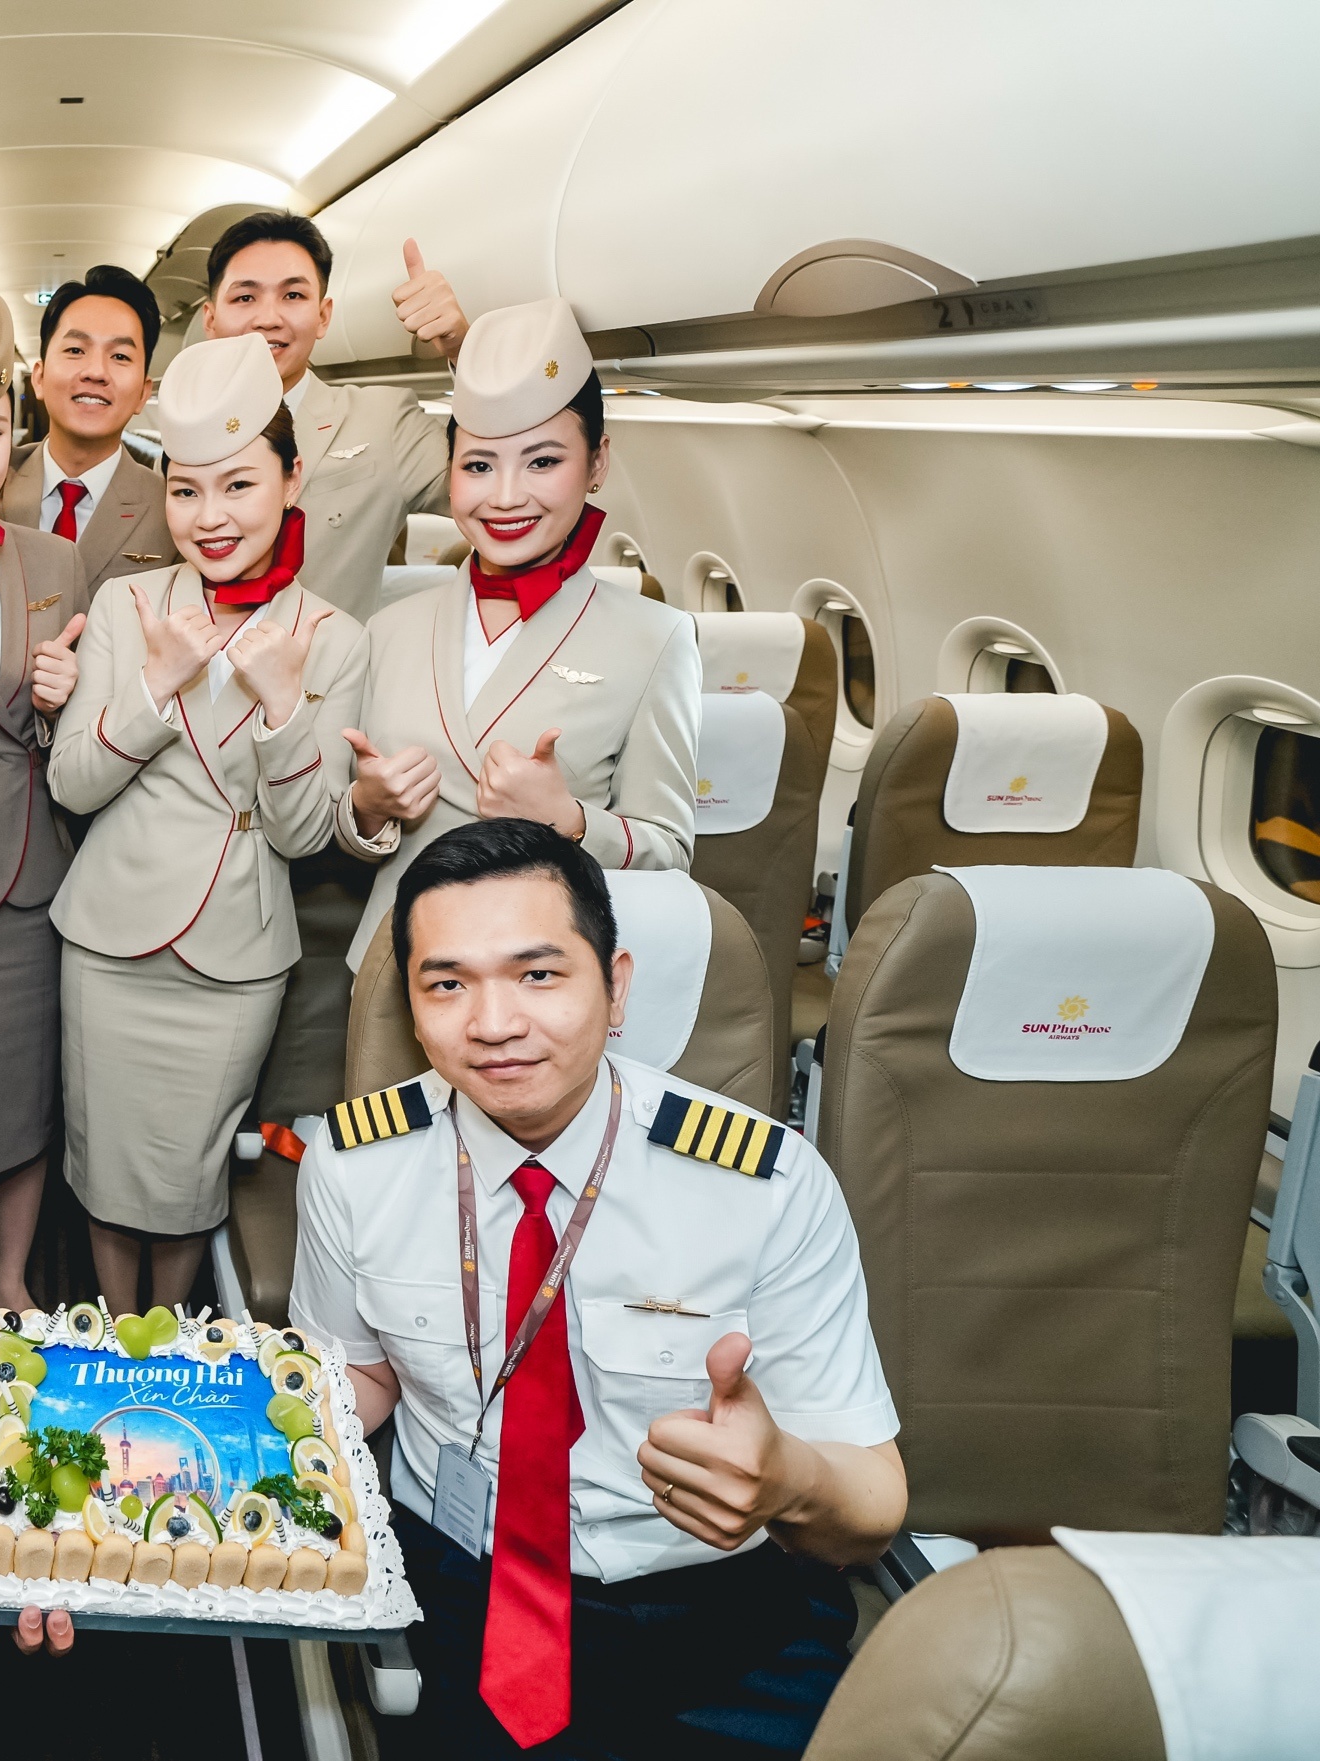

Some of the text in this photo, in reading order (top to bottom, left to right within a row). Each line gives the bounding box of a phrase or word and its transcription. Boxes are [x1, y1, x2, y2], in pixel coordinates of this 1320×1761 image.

[1022, 1024, 1111, 1034] SUN PhuQuoc
[591, 1171, 600, 1186] SUN
[548, 1272, 557, 1287] SUN
[70, 1361, 243, 1387] Thượng Hải
[503, 1362, 512, 1377] SUN
[116, 1383, 243, 1406] Xin Chào
